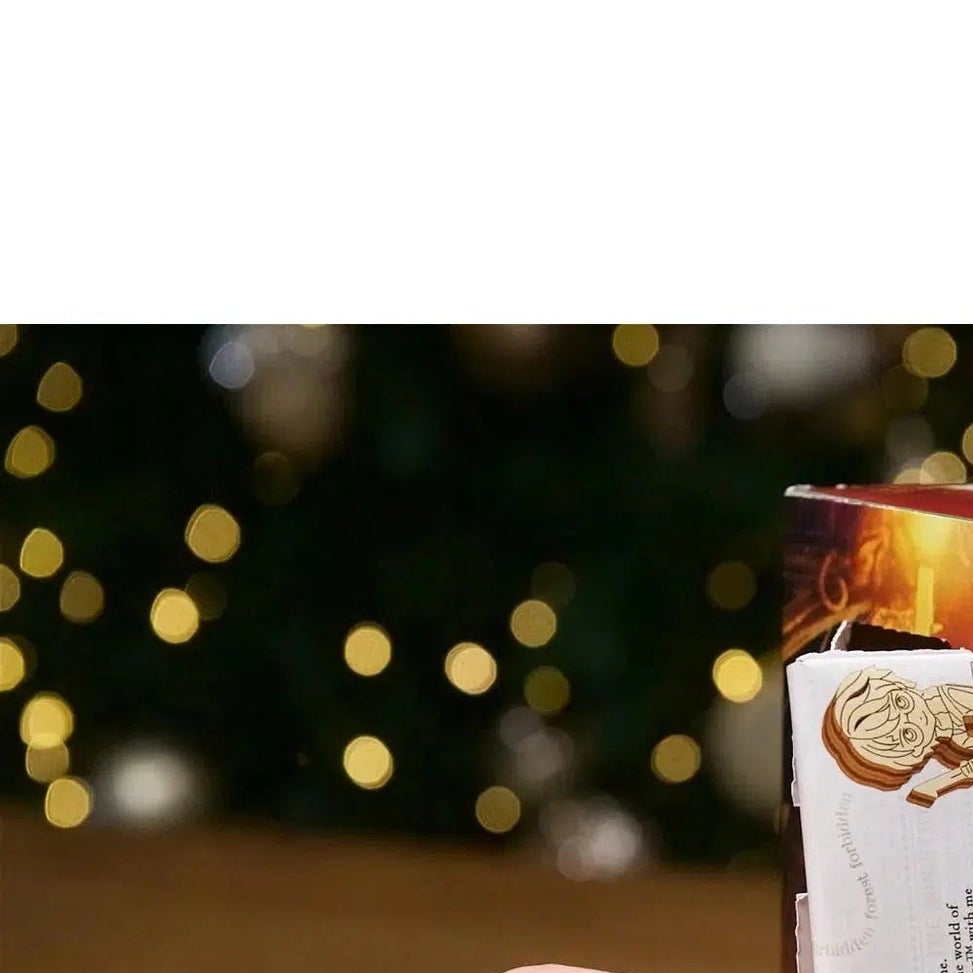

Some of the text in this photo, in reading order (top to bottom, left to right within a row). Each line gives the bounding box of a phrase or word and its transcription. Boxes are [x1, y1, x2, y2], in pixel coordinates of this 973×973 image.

[833, 792, 863, 869] forbidden
[857, 871, 881, 921] forest
[945, 903, 961, 921] of
[964, 888, 973, 908] me
[949, 923, 963, 960] world
